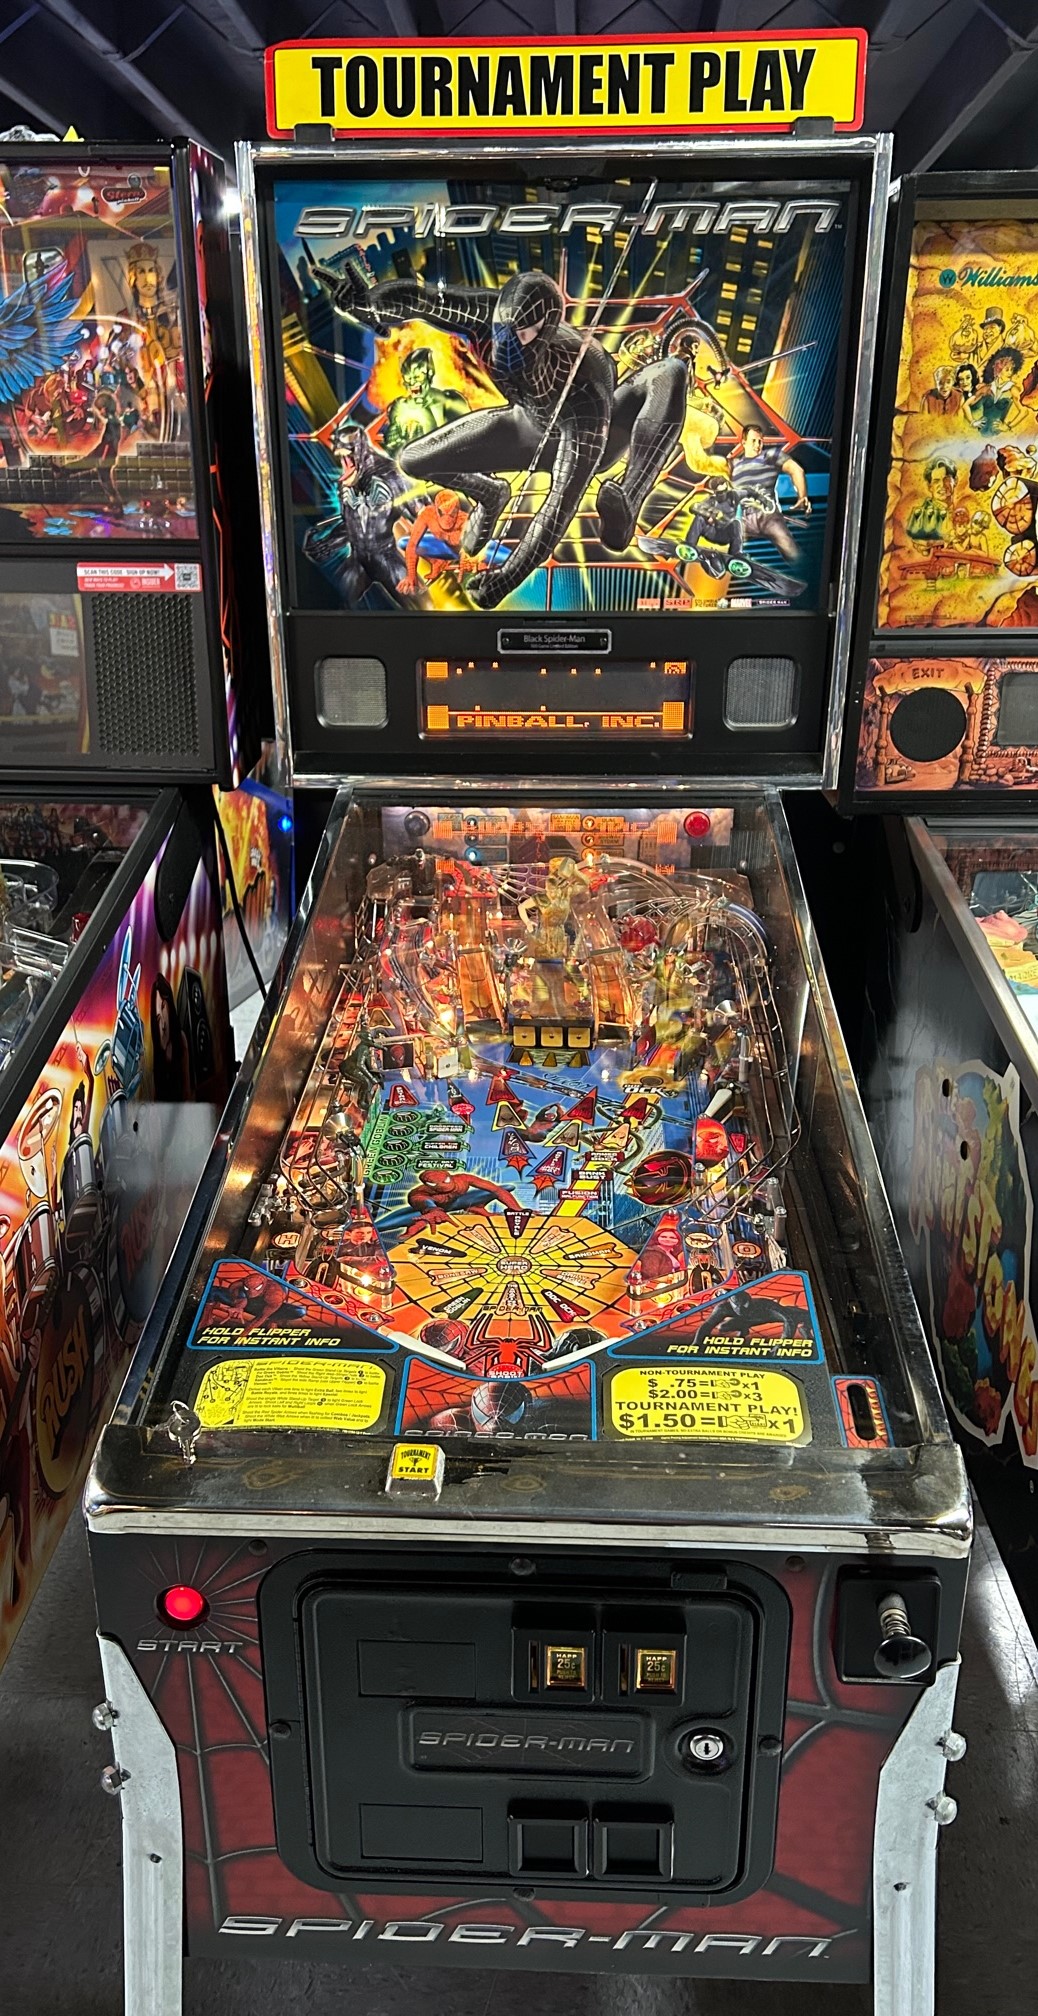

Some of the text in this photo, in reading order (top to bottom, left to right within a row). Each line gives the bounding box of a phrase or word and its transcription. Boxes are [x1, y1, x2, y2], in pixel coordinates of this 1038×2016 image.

[312, 48, 817, 119] TOURNAMENT PLAY
[295, 199, 841, 240] SPIDER-MAN
[958, 266, 1038, 287] Williams
[523, 634, 586, 644] Black Spider-Man
[911, 667, 945, 680] EXIT
[601, 715, 660, 728] INC.
[422, 1244, 452, 1254] VENOM
[568, 1248, 612, 1259] SANDMAN
[544, 1290, 577, 1317] DOC OCK
[202, 1327, 311, 1337] HOLD FLIPPER
[197, 1336, 341, 1346] FOR INSTANT INFO
[703, 1336, 814, 1348] HOLD FLIPPER
[666, 1344, 813, 1357] FOR INSTANT INFO
[40, 1303, 89, 1458] RUSH
[639, 1370, 737, 1378] NON-TOURNAMENT
[615, 1401, 798, 1416] TOURNAMENT PLAY!
[400, 1449, 432, 1460] TOURNAMENT
[397, 1466, 430, 1474] START
[136, 1639, 244, 1654] START
[418, 1731, 636, 1754] SPIDER-MAN
[217, 1914, 834, 1960] SPIDER-MAN
